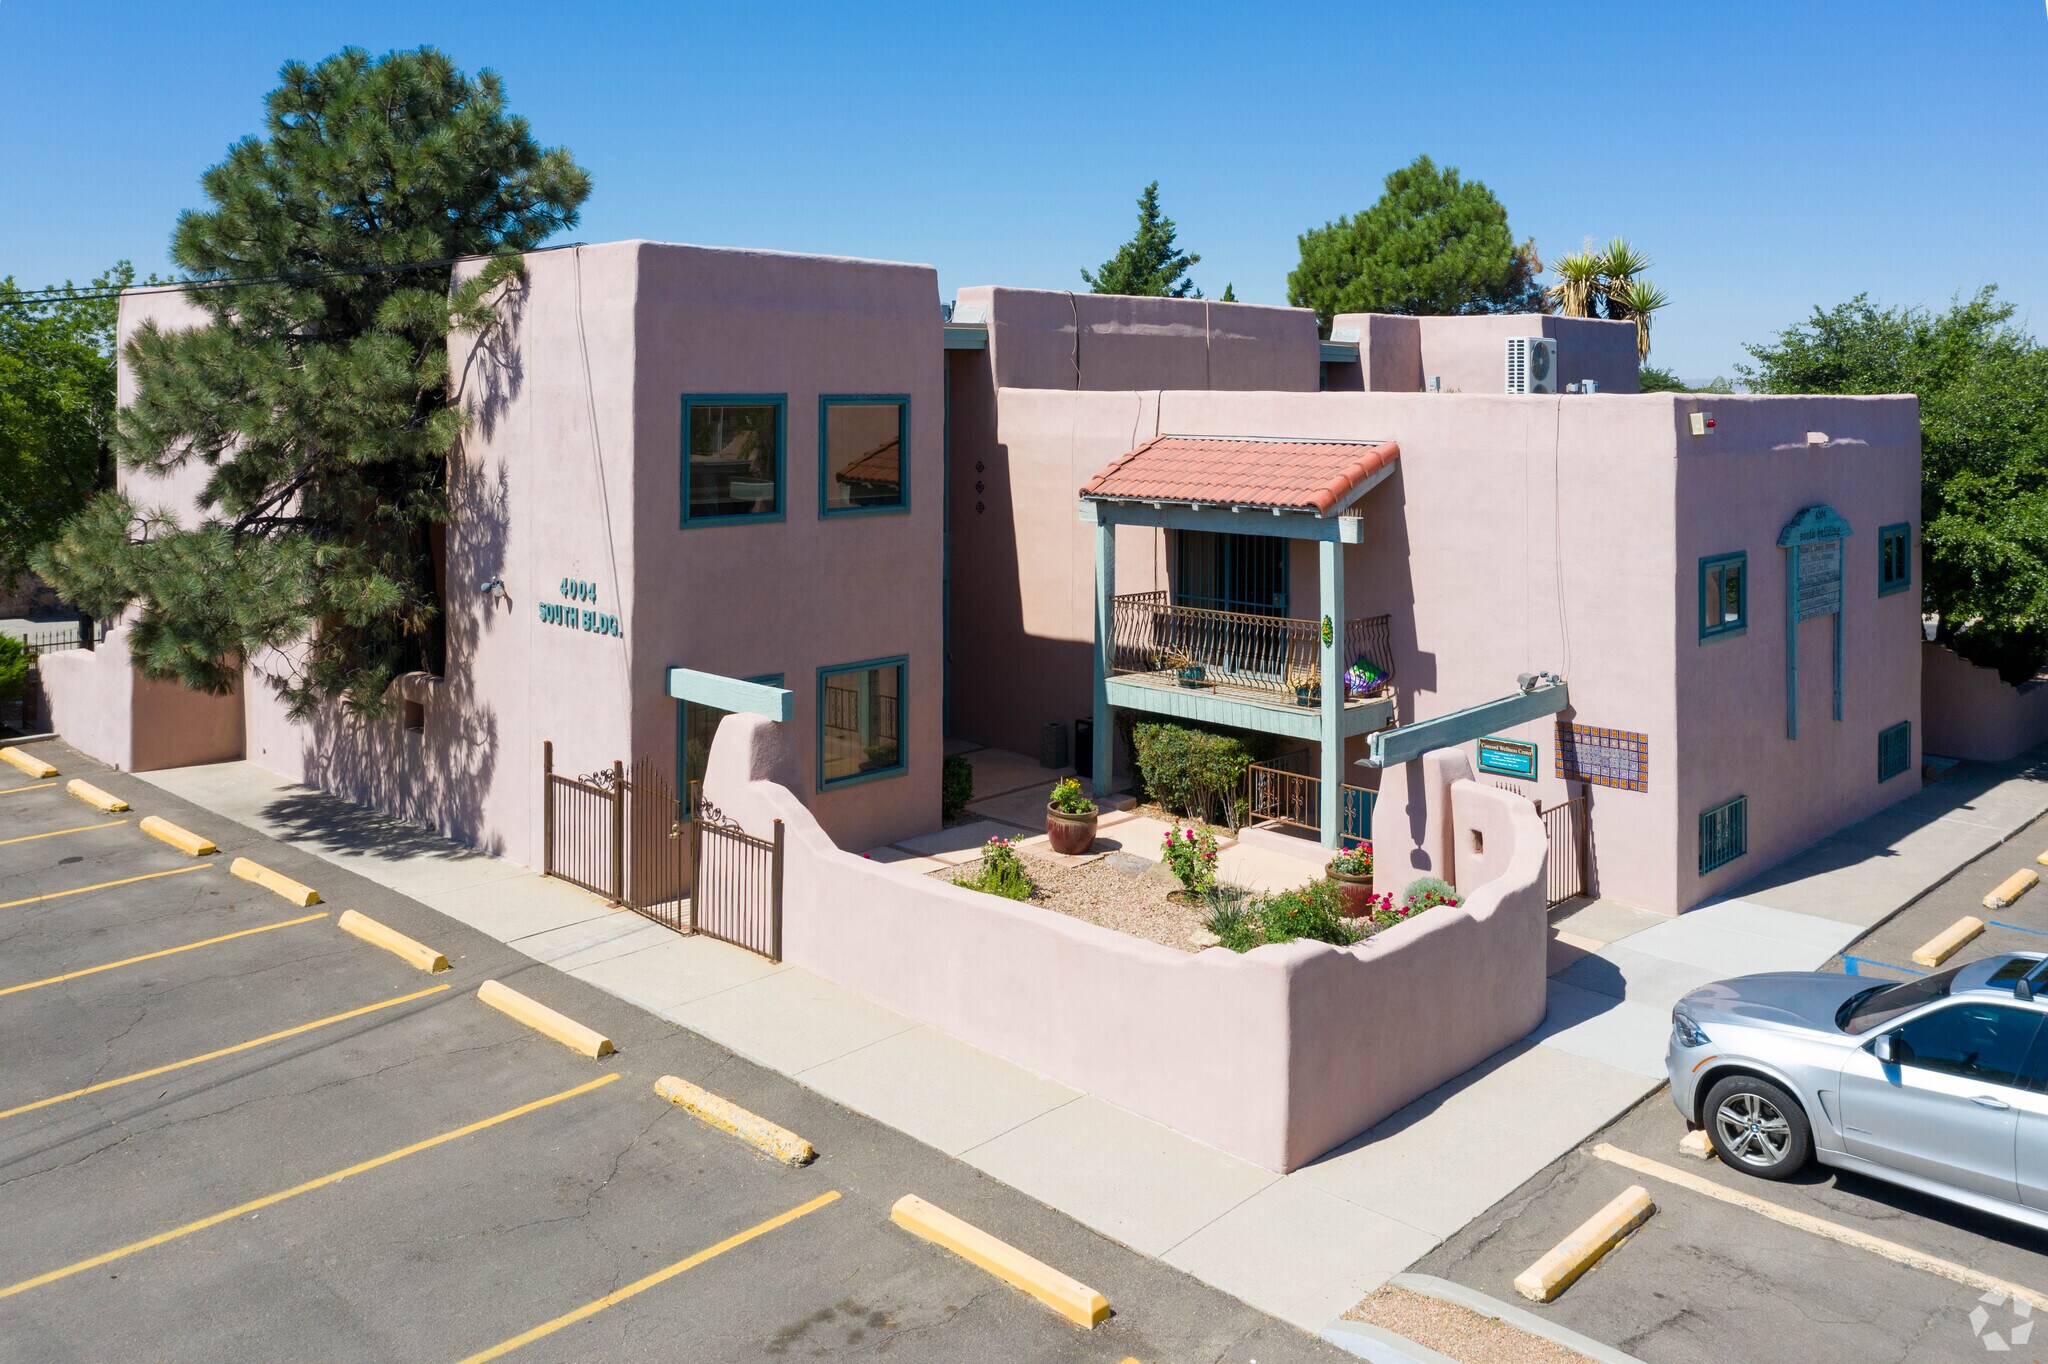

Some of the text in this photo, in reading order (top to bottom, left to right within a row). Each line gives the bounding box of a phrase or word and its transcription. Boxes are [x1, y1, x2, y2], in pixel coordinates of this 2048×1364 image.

[560, 577, 596, 604] 4004
[539, 601, 623, 638] SOUTH BLDG.
